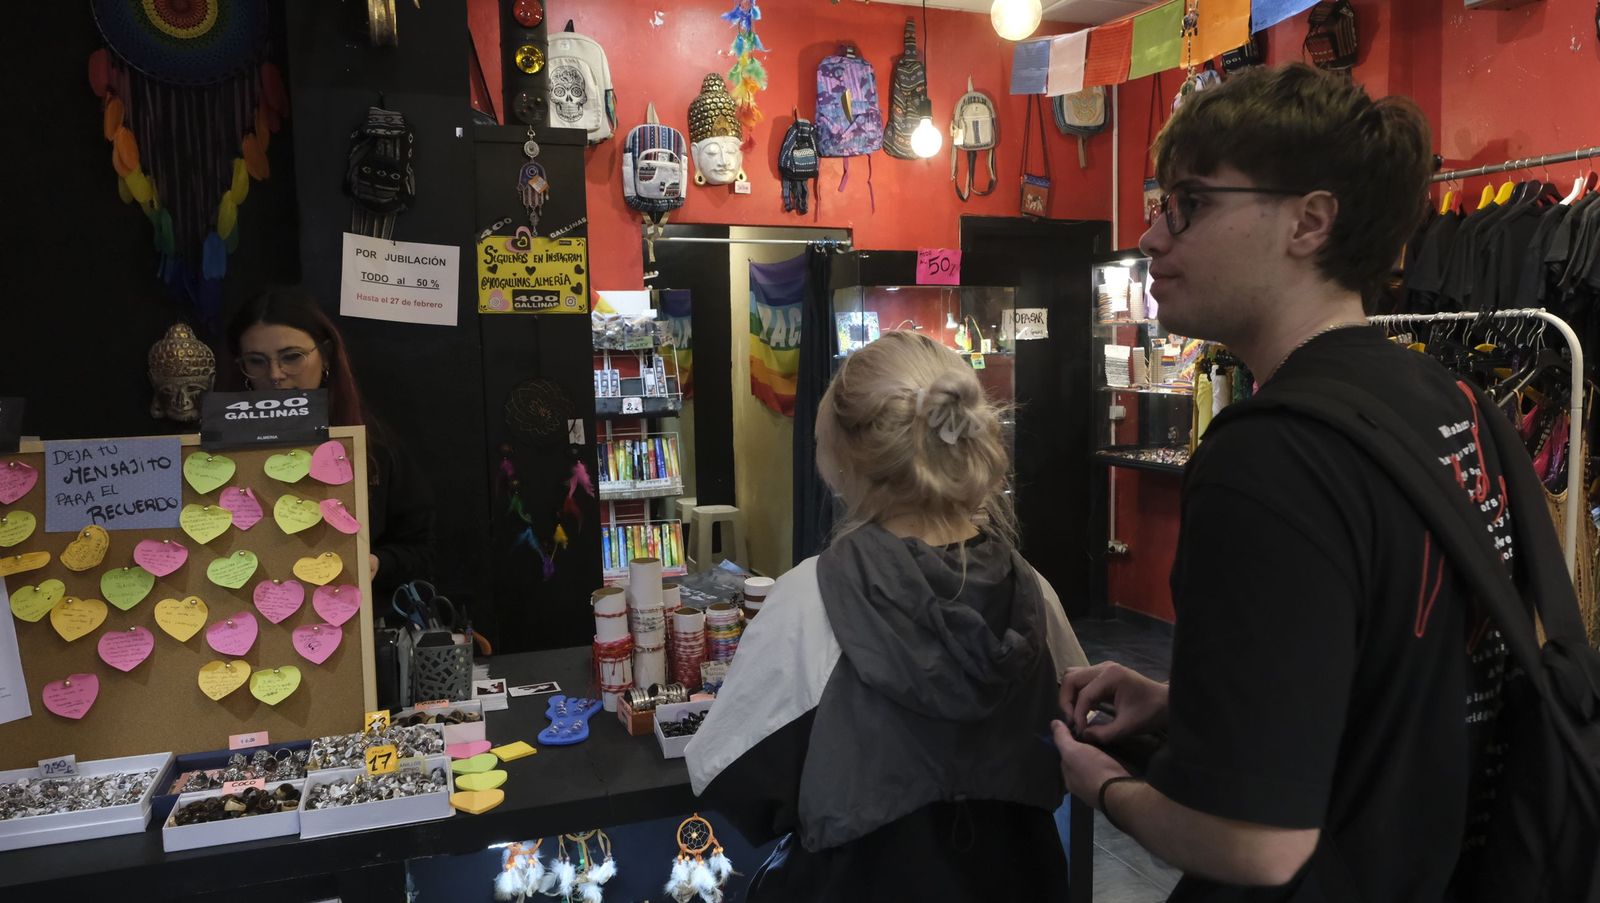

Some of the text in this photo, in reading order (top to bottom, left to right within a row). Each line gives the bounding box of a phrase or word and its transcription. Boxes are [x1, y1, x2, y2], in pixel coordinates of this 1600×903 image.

[480, 217, 512, 239] 400
[549, 216, 587, 239] GALLINAS
[355, 248, 447, 266] POR JUBILACIÓN
[533, 254, 543, 263] EN
[360, 271, 440, 288] TODO al 50 %
[356, 293, 443, 309] Hasta el 27 de febrero
[225, 397, 309, 411] 400
[224, 407, 310, 420] GALLINAS
[52, 445, 118, 465] DEJA TU
[55, 485, 119, 507] PARA EL
[86, 496, 179, 525] RECUERDO
[368, 752, 392, 772] 17
[231, 780, 256, 788] COCO
